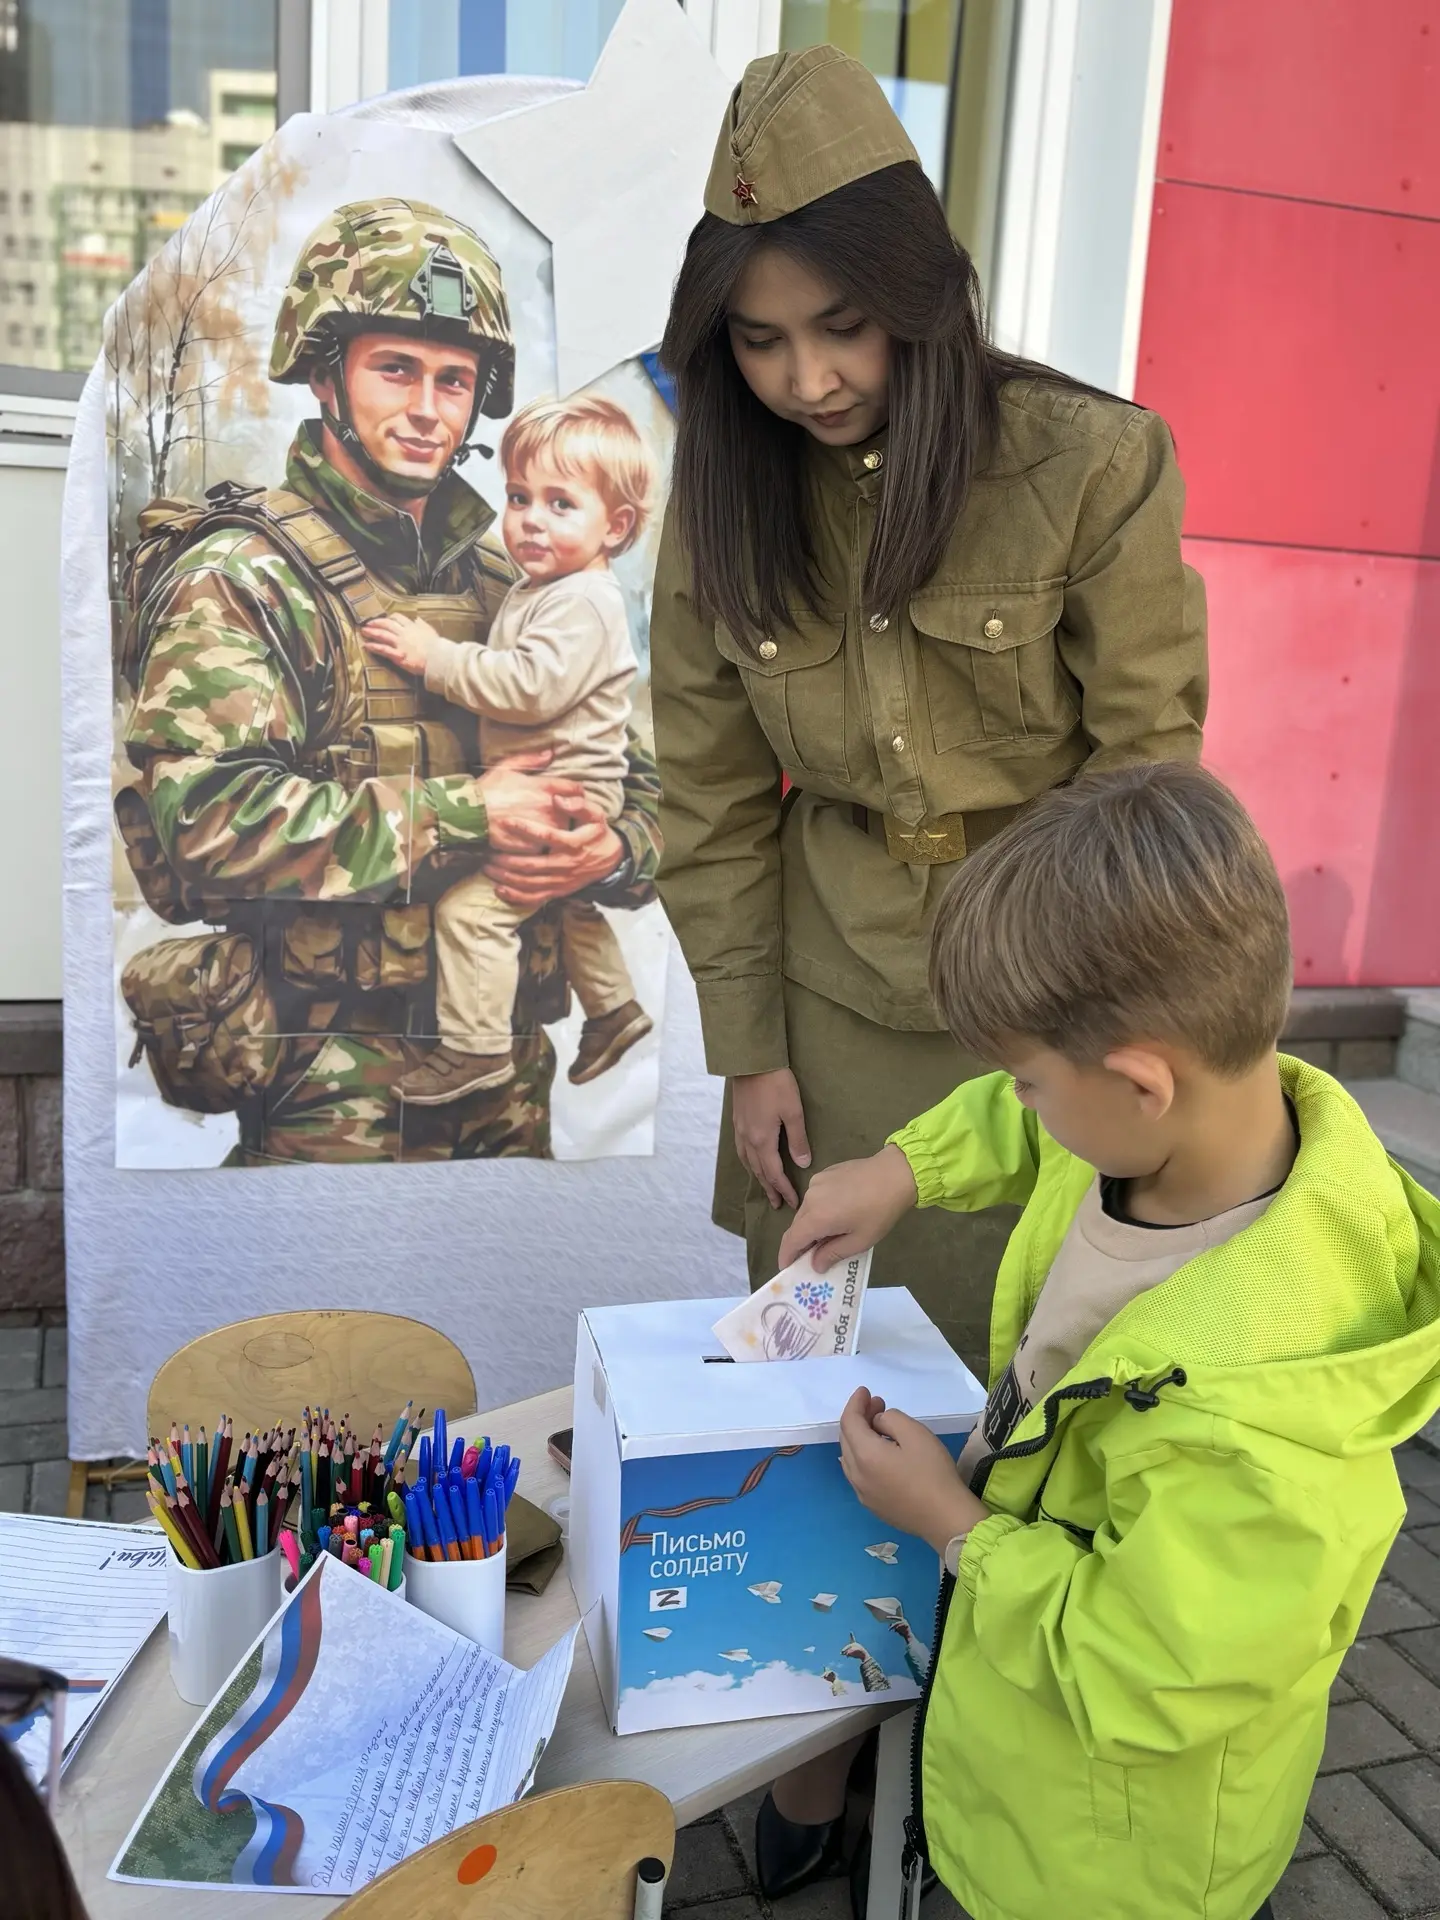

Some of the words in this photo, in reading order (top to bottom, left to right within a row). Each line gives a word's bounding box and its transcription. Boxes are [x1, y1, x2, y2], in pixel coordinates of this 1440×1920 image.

[842, 1259, 859, 1307] дома
[650, 1530, 746, 1557] Письмо
[649, 1551, 749, 1578] солдату
